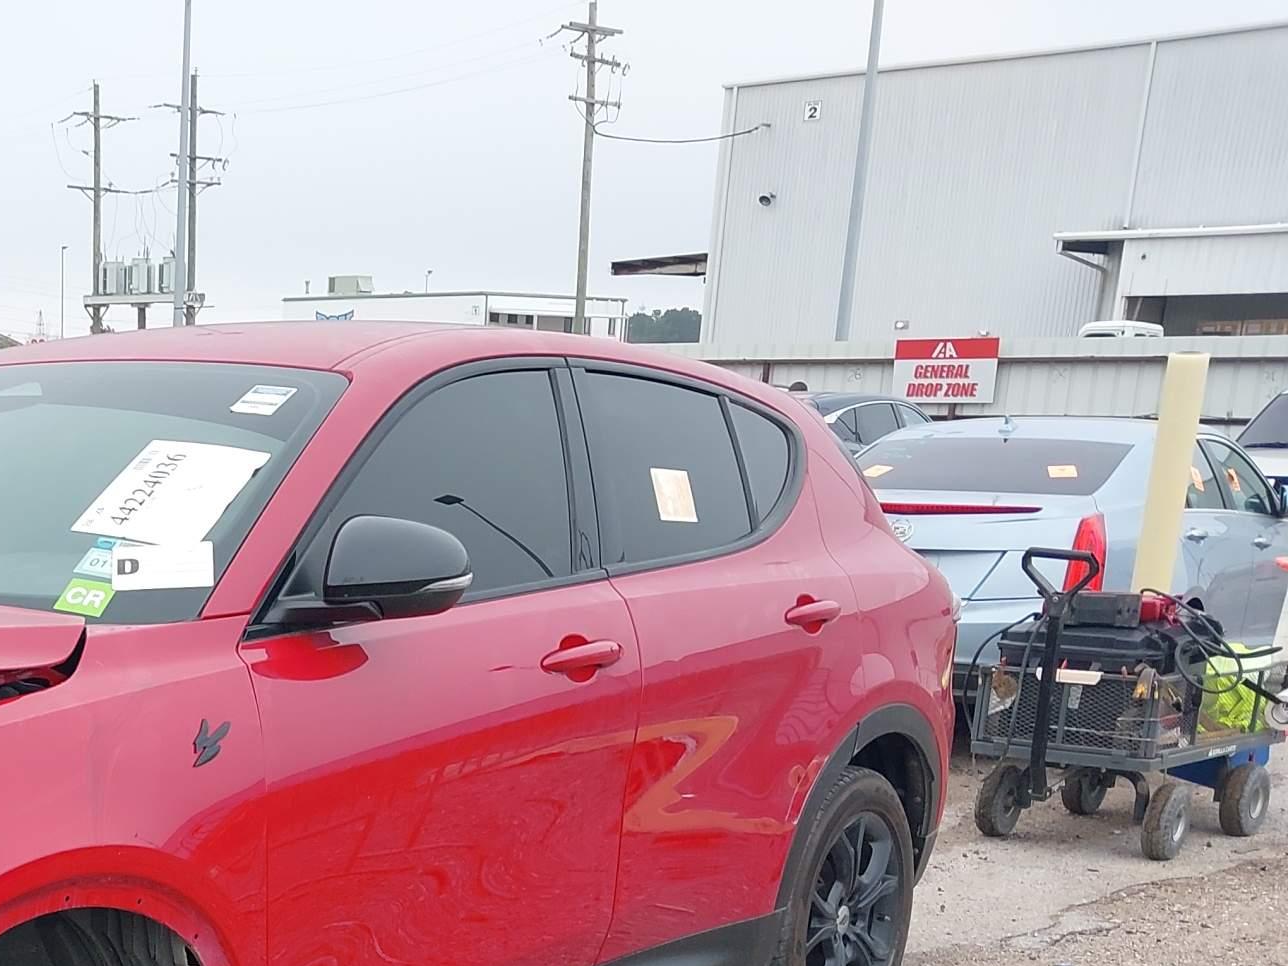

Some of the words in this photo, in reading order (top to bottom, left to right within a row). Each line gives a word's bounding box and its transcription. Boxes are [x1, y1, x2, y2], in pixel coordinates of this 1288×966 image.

[807, 106, 818, 119] 2
[914, 364, 970, 379] GENERAL
[906, 383, 943, 397] DROP
[943, 383, 979, 397] ZONE
[110, 452, 187, 526] 44224036
[89, 557, 108, 568] 01
[117, 558, 140, 575] D
[65, 586, 105, 608] CR
